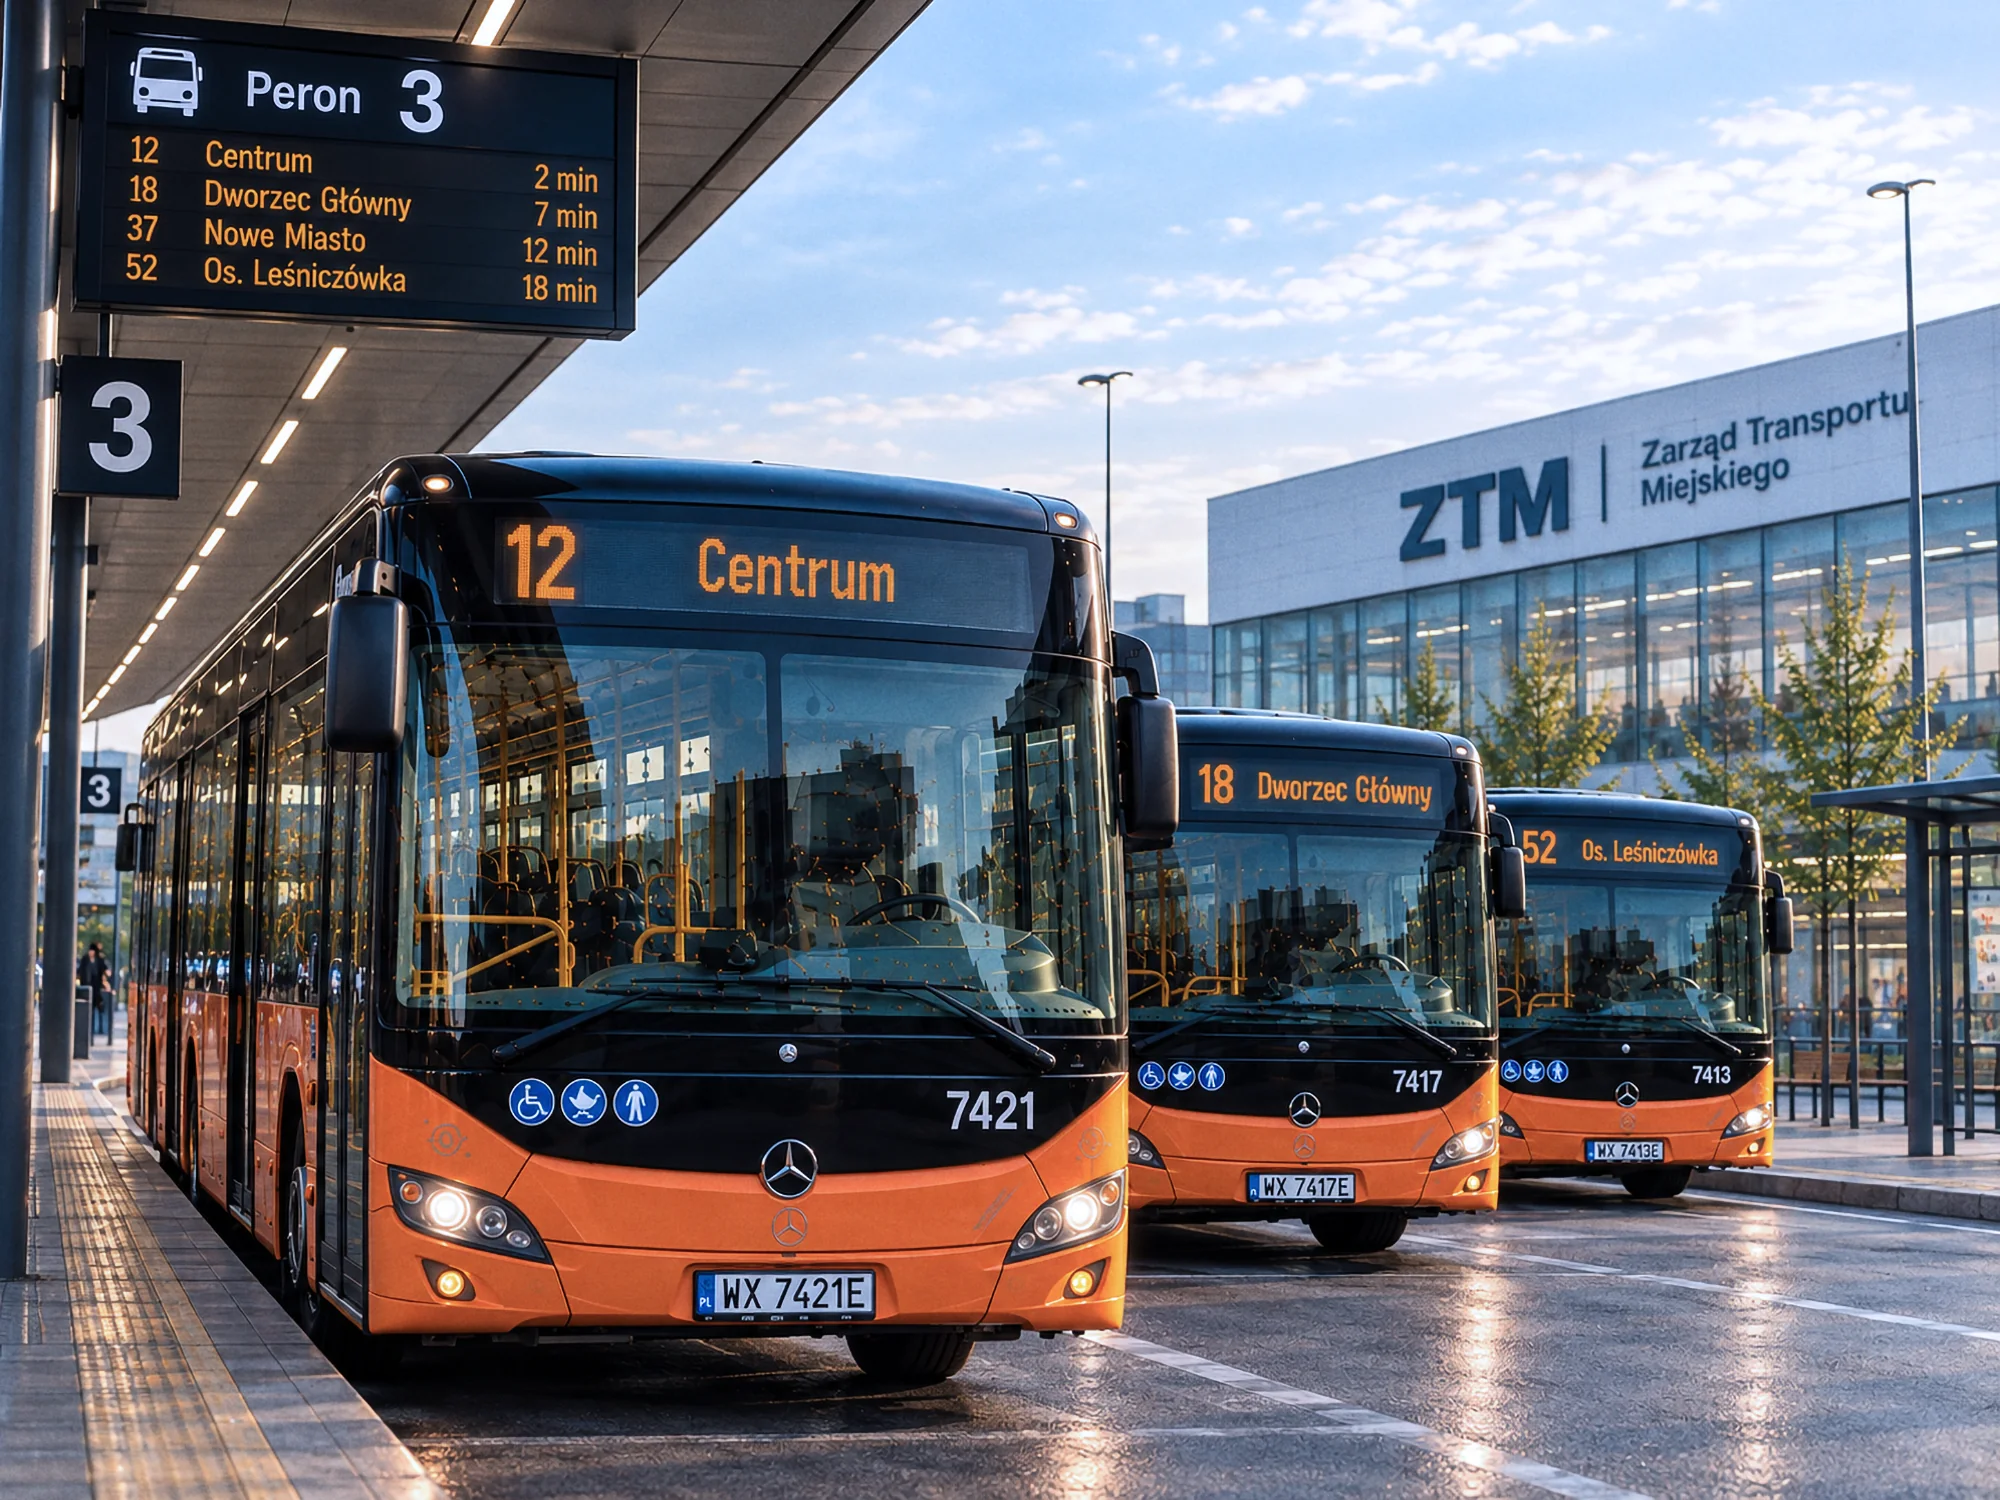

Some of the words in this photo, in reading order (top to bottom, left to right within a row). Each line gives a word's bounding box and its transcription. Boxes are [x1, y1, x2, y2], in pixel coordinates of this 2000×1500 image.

[246, 70, 361, 114] Peron
[400, 69, 444, 133] 3
[130, 135, 160, 164] 12
[205, 140, 313, 173] Centrum
[534, 163, 549, 190] 2
[557, 166, 598, 193] min
[129, 175, 159, 203] 18
[204, 179, 311, 211] Dworzec
[321, 186, 412, 222] Główny
[534, 201, 549, 226] 7
[556, 203, 598, 229] min
[126, 214, 159, 242] 37
[204, 218, 275, 248] Nowe
[285, 222, 366, 253] Miasto
[522, 237, 549, 263] 12
[556, 240, 597, 267] min
[125, 253, 158, 281] 52
[203, 257, 243, 284] Os.
[253, 258, 407, 293] Leśniczówka
[522, 273, 549, 301] 18
[556, 277, 597, 303] min
[88, 381, 153, 473] 3
[1641, 421, 1738, 469] Zarząd
[1746, 390, 1909, 437] Transportu
[1641, 457, 1790, 508] Miejskiego
[1400, 456, 1569, 562] ZTM
[507, 524, 576, 600] 12
[698, 537, 895, 603] Centrum
[87, 774, 111, 808] 3
[1198, 763, 1234, 804] 18
[1258, 771, 1348, 802] Dworzec
[1355, 775, 1433, 812] Główny
[1522, 830, 1557, 865] 52
[1582, 839, 1608, 862] Os.
[1613, 839, 1718, 866] Leśniczówka
[1393, 1069, 1443, 1094] 7417
[1693, 1065, 1732, 1084] 7413
[946, 1090, 1034, 1130] 7421
[1620, 1143, 1659, 1158] 7413E
[1264, 1177, 1287, 1197] WX
[1294, 1177, 1349, 1197] 7417E
[700, 1297, 712, 1308] PL
[723, 1278, 761, 1309] WX
[775, 1277, 865, 1309] 7421E
